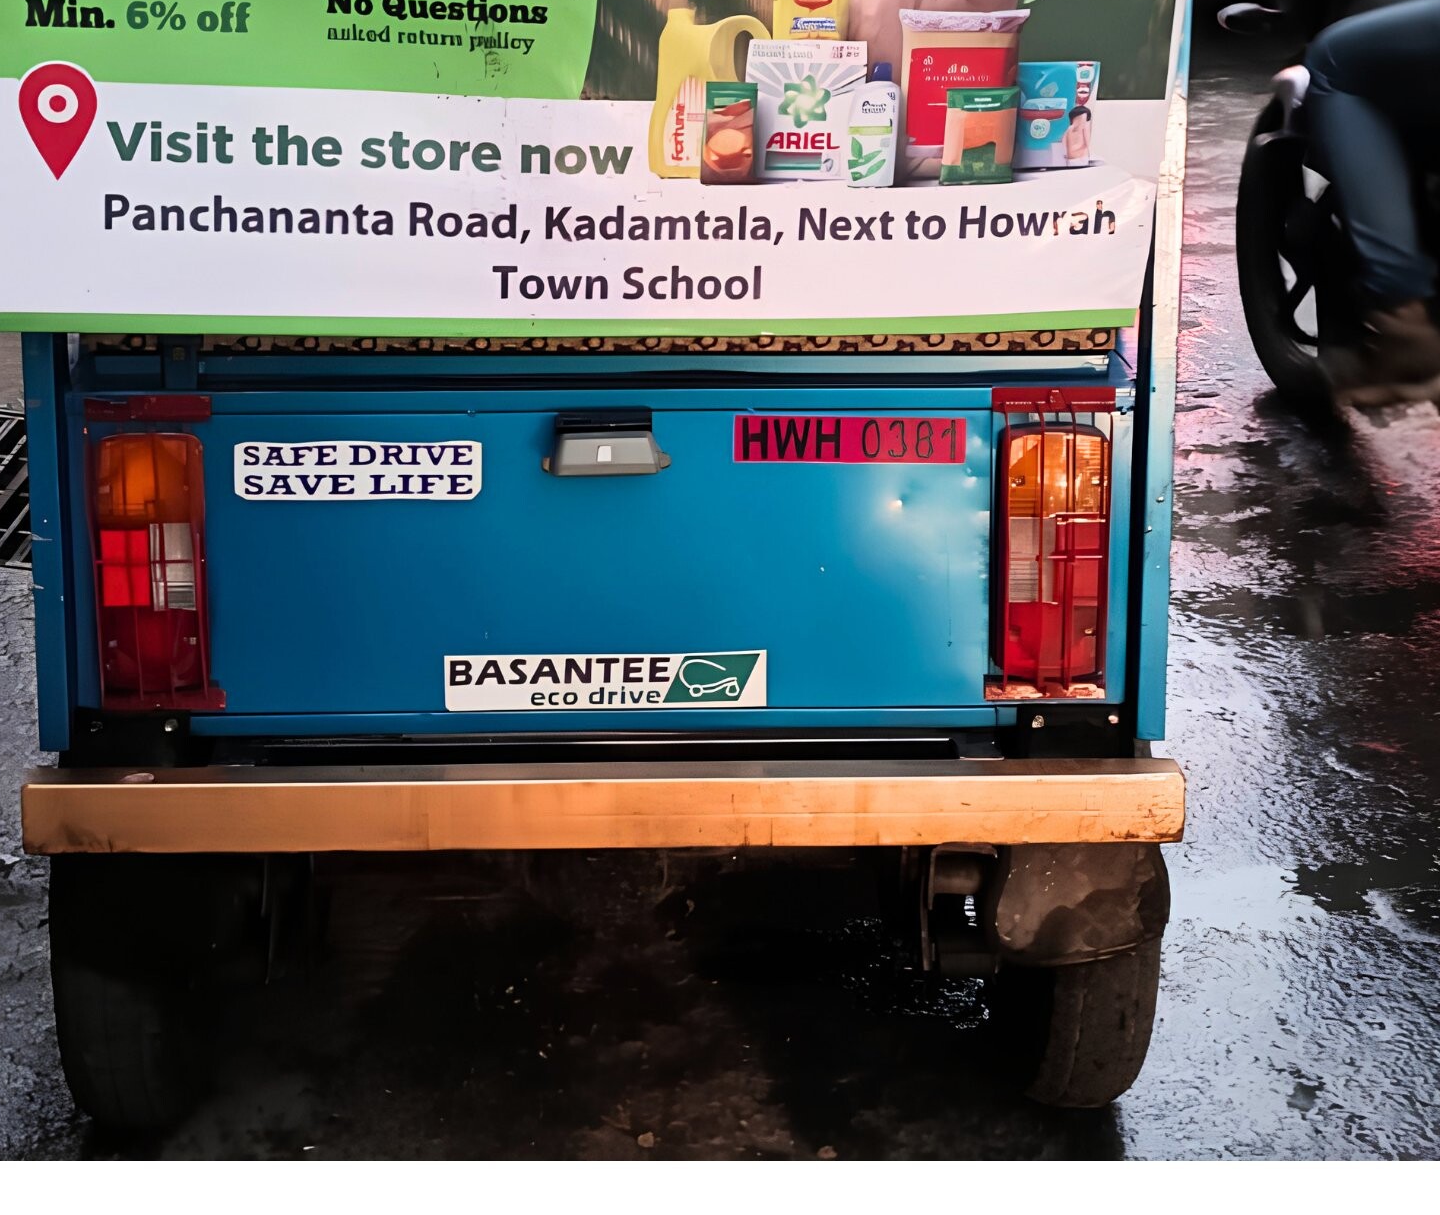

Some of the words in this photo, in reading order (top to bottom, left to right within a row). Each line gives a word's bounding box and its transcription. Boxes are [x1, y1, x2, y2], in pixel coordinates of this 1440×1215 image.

[127, 1, 186, 30] 6%
[197, 2, 251, 32] off
[106, 121, 233, 164] Visit
[252, 125, 342, 167] the
[361, 131, 501, 172] store
[521, 145, 633, 175] now
[765, 131, 841, 151] ARIEL
[105, 194, 393, 235] Panchananta
[410, 202, 530, 244] Road,
[545, 205, 784, 245] Kadamtala,
[798, 208, 894, 241] Next
[905, 211, 946, 240] to
[959, 200, 1115, 239] Howrah
[492, 266, 608, 299] Town
[623, 265, 761, 300] School
[742, 417, 841, 459] HWH
[861, 419, 956, 460] 0381
[243, 445, 337, 466] SAFE
[349, 445, 472, 465] DRIVE
[244, 475, 355, 495] SAVE
[369, 475, 473, 495] LIFE
[449, 657, 670, 686] BASANTEE
[531, 692, 578, 706] eco
[589, 686, 661, 705] drive
